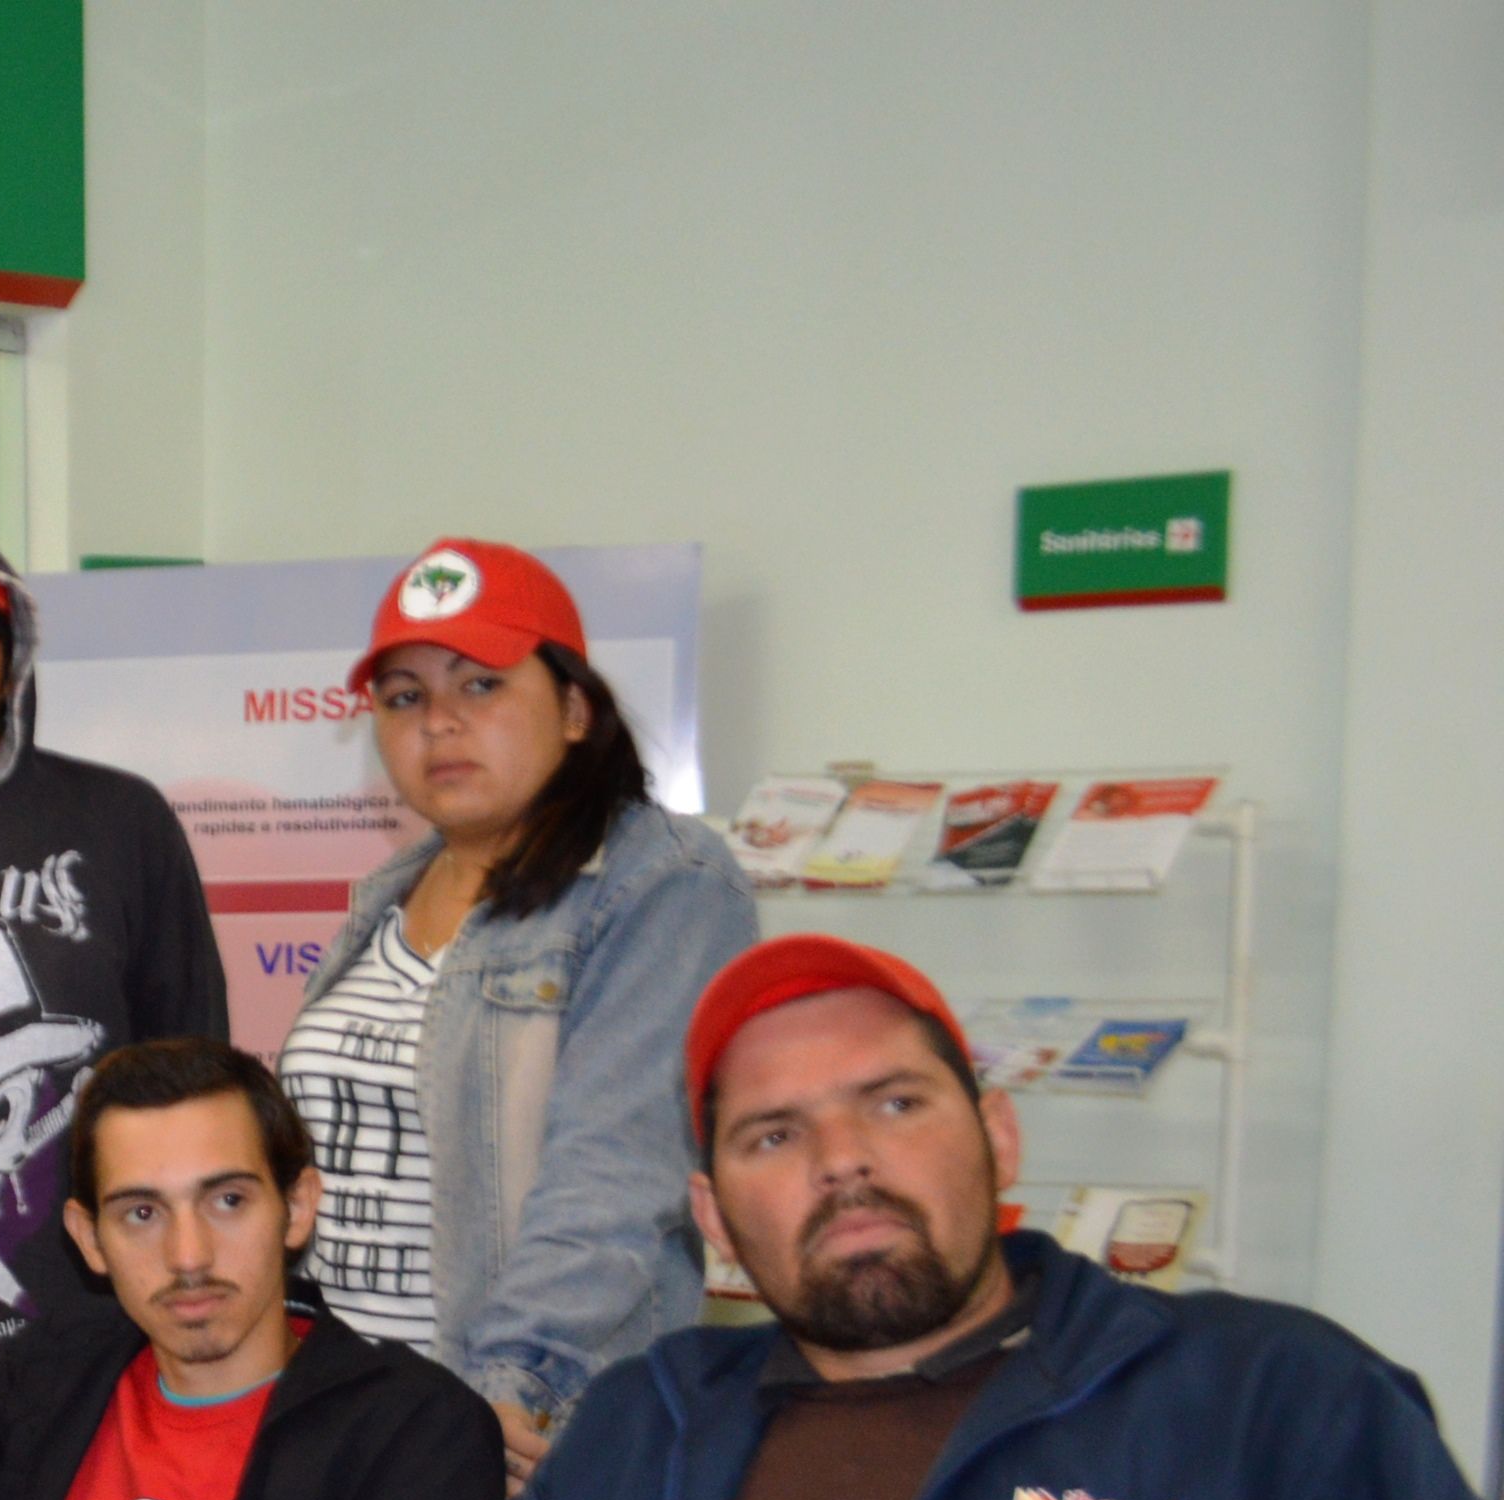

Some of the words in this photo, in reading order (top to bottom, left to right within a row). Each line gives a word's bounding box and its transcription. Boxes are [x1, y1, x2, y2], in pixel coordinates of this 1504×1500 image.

[244, 686, 374, 723] MISSA
[172, 797, 267, 813] tendimento
[256, 942, 323, 975] VIS
